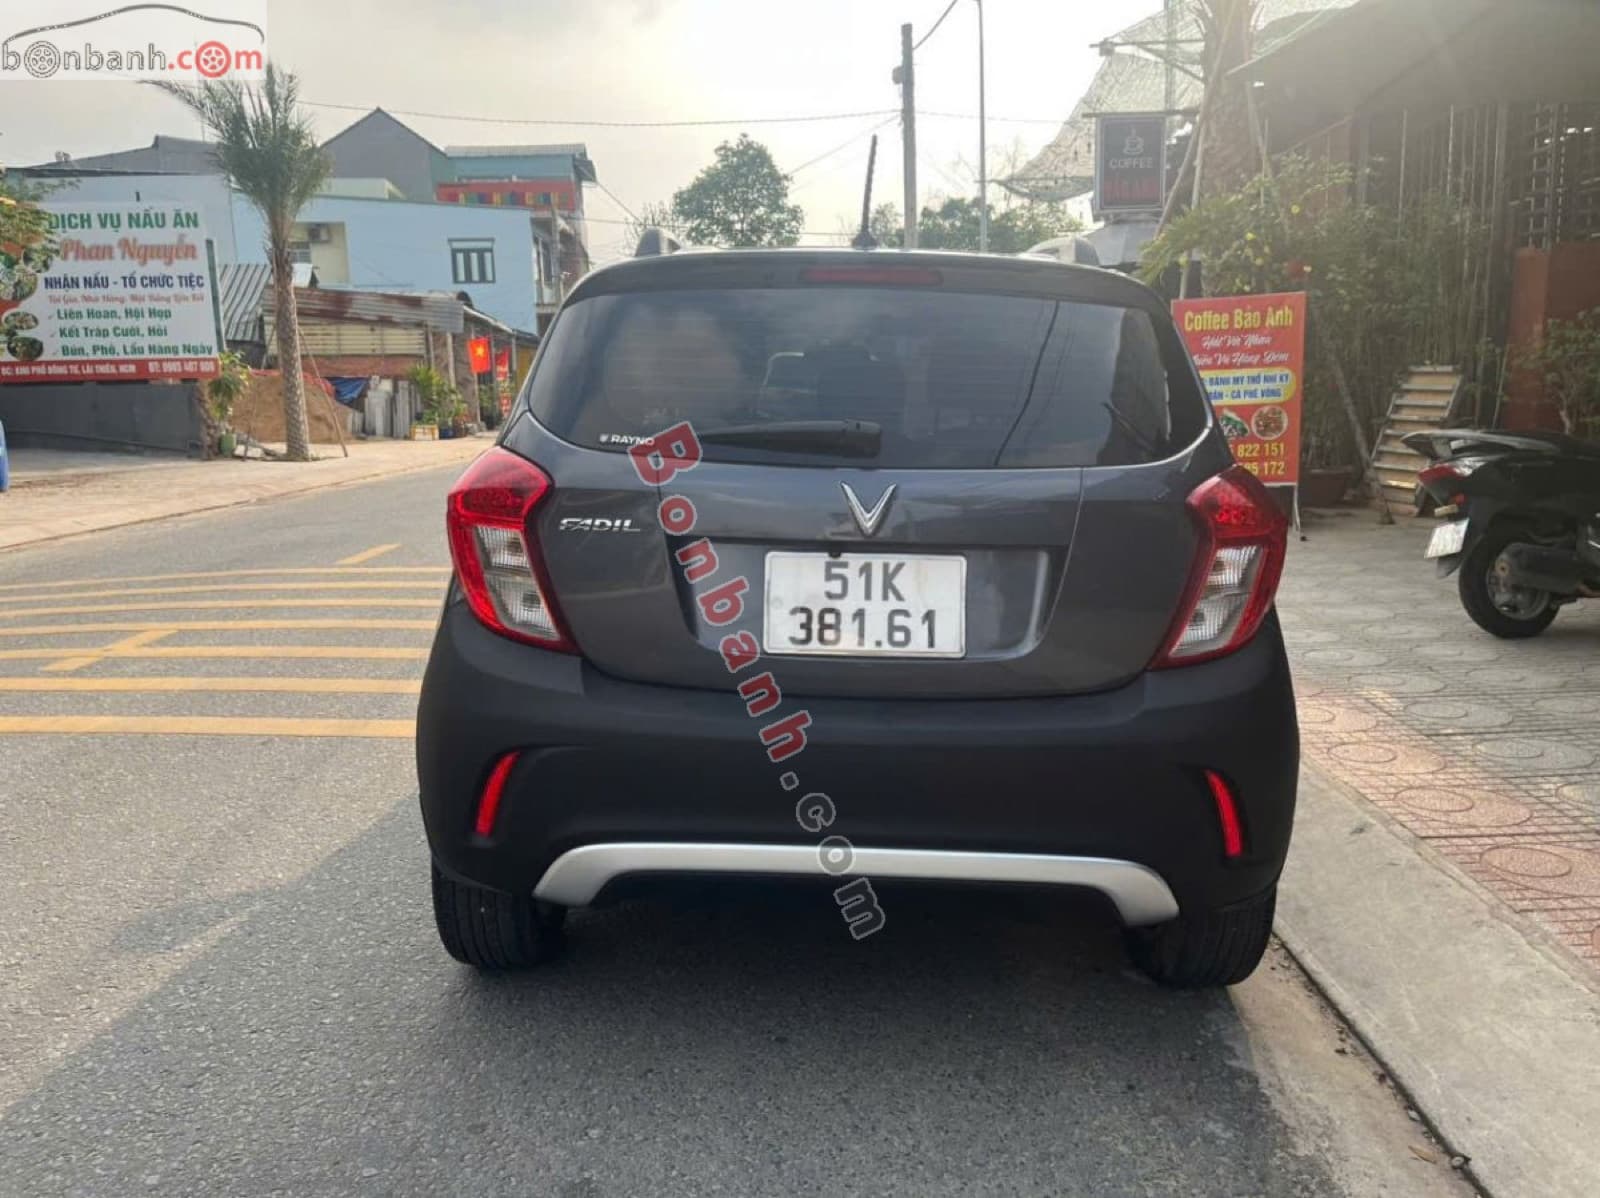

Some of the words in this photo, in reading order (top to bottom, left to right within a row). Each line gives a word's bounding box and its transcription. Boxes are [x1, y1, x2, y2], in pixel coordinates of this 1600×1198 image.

[49, 211, 92, 233] DỊCH
[97, 211, 121, 233] VỤ
[127, 207, 166, 229] NẤU
[173, 208, 199, 229] ĂN
[61, 238, 114, 261] Phan
[44, 273, 80, 292] NHẬN
[83, 271, 109, 289] NẤU
[177, 272, 204, 291] TIỆC
[57, 308, 83, 320] Liên
[124, 307, 145, 321] Hội
[149, 308, 172, 321] Họp
[1184, 309, 1230, 332] Coffee
[610, 434, 655, 446] RAYNO
[1237, 443, 1259, 458] 822
[1264, 442, 1285, 457] 151
[1263, 460, 1285, 476] 172
[560, 518, 640, 531] FADIL
[824, 561, 906, 603] 51K
[788, 608, 937, 649] 381.61
